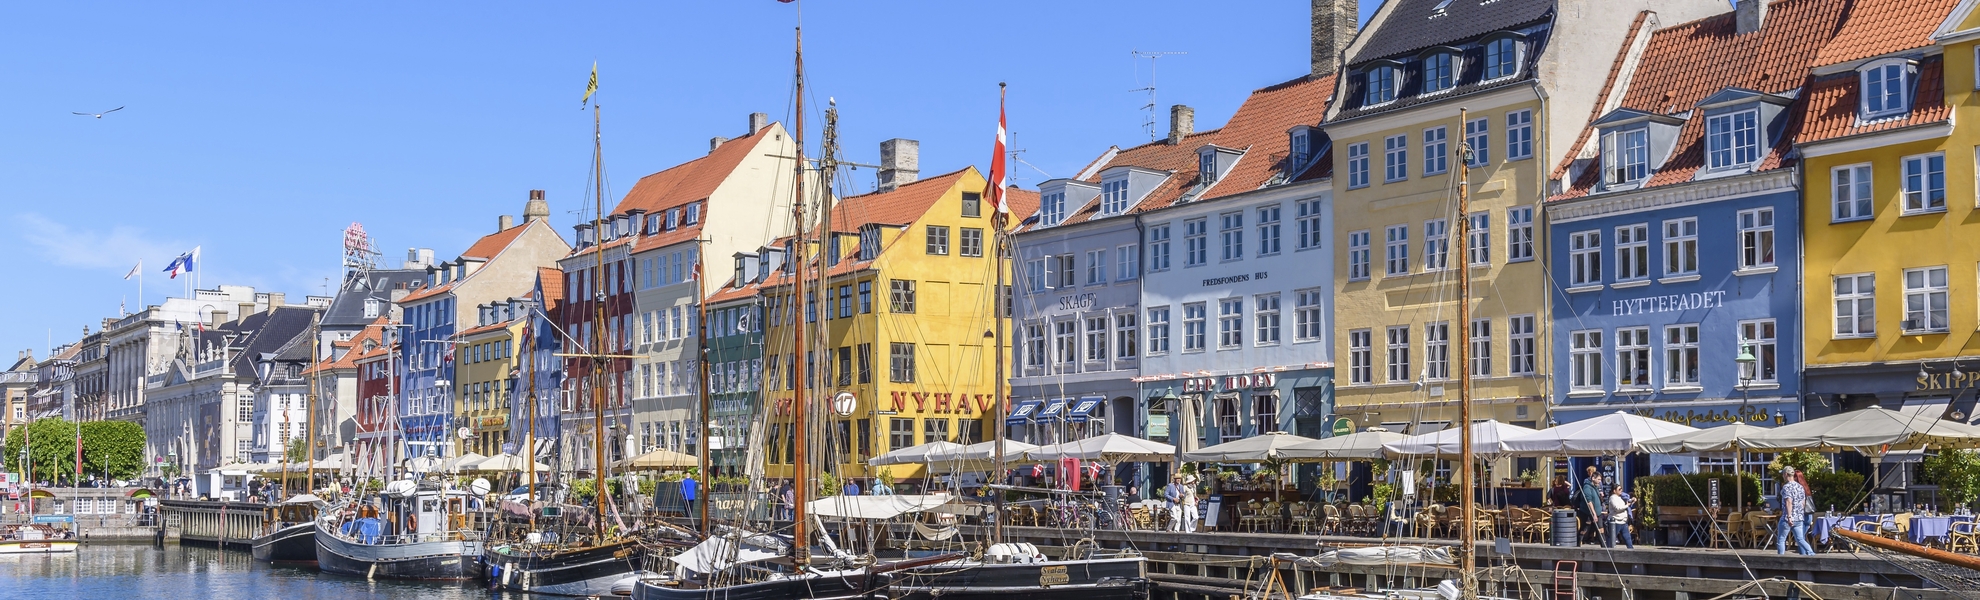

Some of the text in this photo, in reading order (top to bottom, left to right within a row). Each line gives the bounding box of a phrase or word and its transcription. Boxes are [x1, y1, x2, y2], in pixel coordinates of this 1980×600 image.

[1202, 271, 1268, 287] FREDSFONDENS HUS
[1612, 290, 1726, 317] HYTTEFADET
[1183, 373, 1276, 392] CAP HORN
[836, 395, 854, 413] 17
